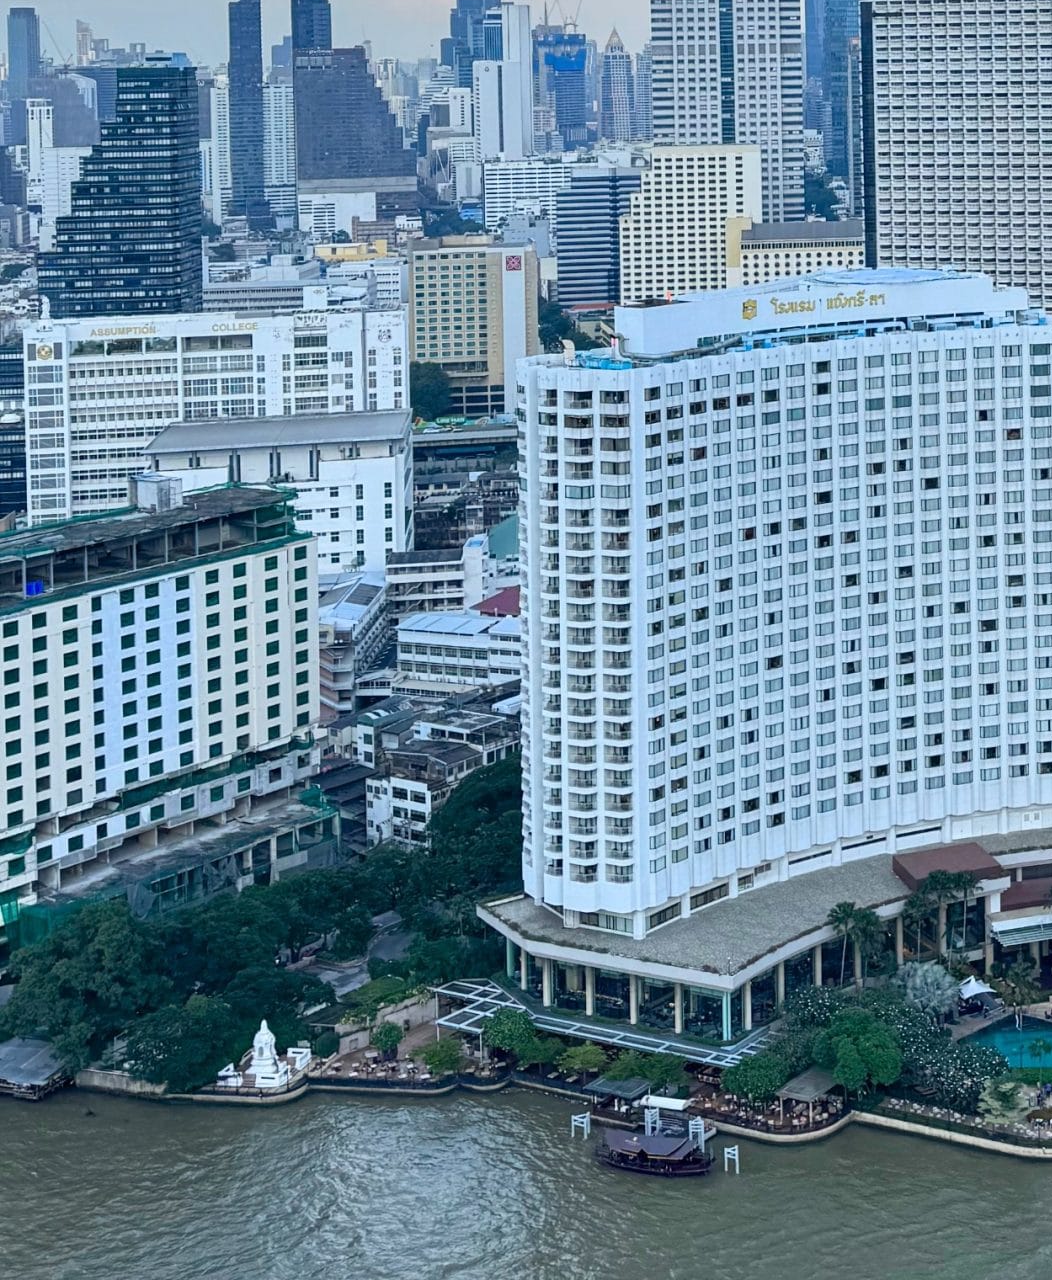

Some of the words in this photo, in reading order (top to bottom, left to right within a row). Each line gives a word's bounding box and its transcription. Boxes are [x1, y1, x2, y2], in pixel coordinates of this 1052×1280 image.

[769, 296, 816, 315] โรงแรม
[90, 325, 156, 337] ASSUMPTION
[211, 321, 259, 332] COLLEGE
